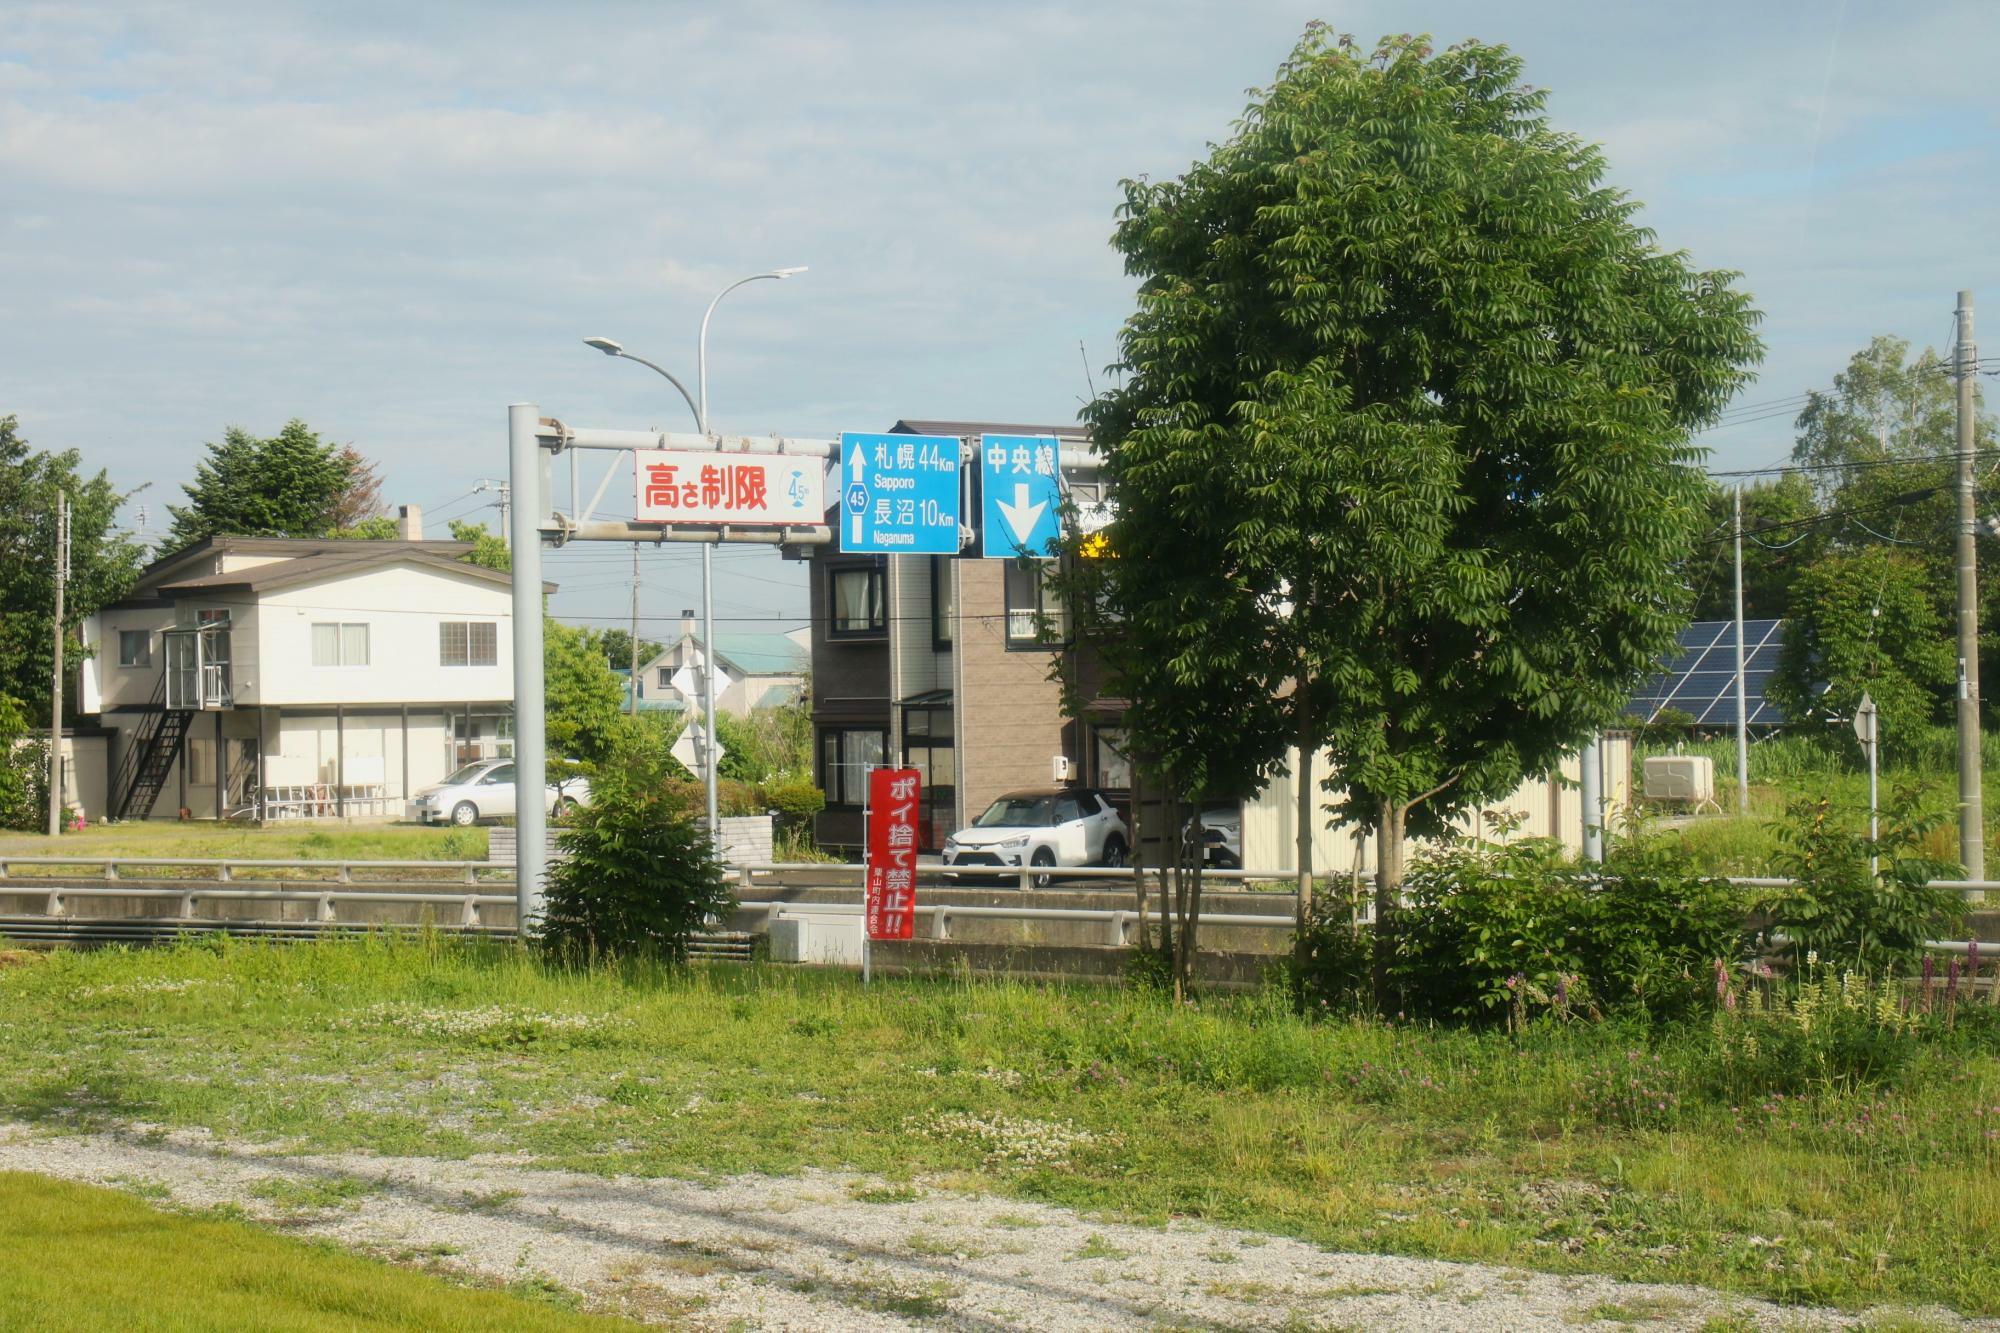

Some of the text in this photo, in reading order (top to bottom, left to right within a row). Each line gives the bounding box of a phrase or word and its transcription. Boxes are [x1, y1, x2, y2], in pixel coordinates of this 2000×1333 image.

[874, 443, 914, 470] 札幌
[987, 443, 1055, 475] 中央線
[645, 463, 767, 511] 高さ制限
[874, 474, 914, 492] Sapporo
[850, 491, 865, 506] 45
[874, 499, 914, 525] 長沼
[873, 530, 914, 547] Naganuma
